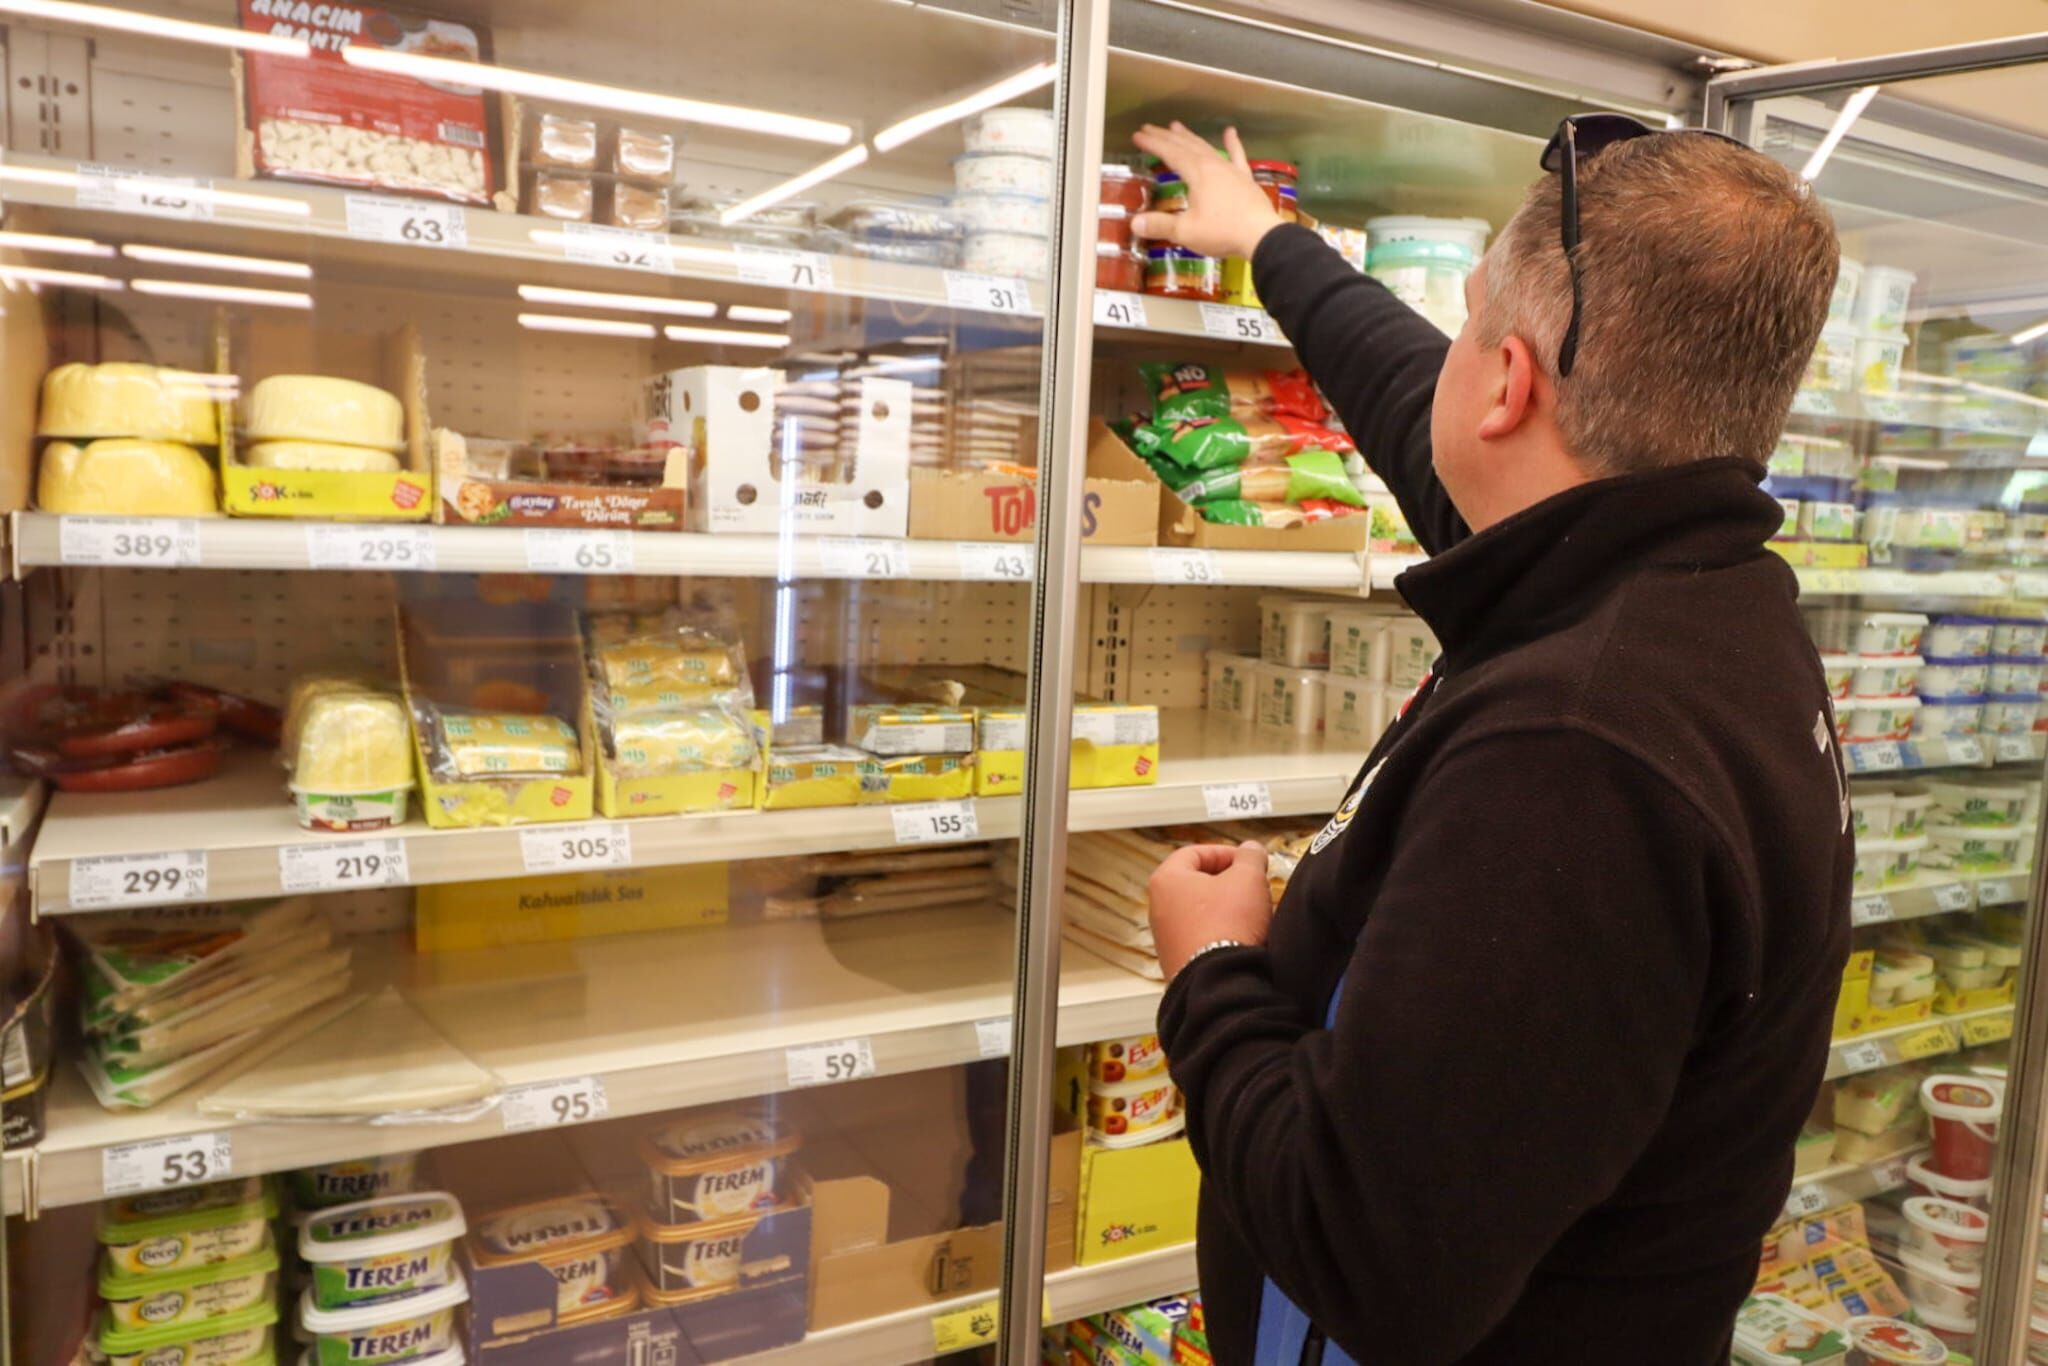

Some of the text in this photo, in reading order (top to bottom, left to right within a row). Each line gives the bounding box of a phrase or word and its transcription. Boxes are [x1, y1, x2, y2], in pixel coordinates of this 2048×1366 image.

[250, 0, 363, 34] ANACIM
[402, 218, 444, 242] 63
[792, 264, 814, 285] 71
[989, 290, 1015, 308] 31
[1107, 304, 1131, 323] 41
[1236, 318, 1262, 338] 55
[114, 534, 172, 556] 389
[361, 540, 412, 561] 295
[575, 544, 612, 568] 65
[865, 552, 891, 575] 21
[994, 556, 1025, 577] 43
[1184, 560, 1209, 581] 33
[1229, 794, 1258, 812] 469
[930, 815, 961, 834] 155
[561, 838, 609, 860] 305
[335, 855, 381, 879] 219
[123, 867, 180, 894] 299
[618, 885, 644, 901] Sos
[826, 1053, 857, 1080] 59
[552, 1092, 590, 1124] 95
[162, 1150, 207, 1184] 53
[316, 1170, 389, 1195] TEREM
[703, 1168, 766, 1195] TEREM
[328, 1206, 432, 1237] TEREM
[142, 1244, 180, 1261] Becel
[694, 1237, 742, 1261] TERE
[346, 1256, 428, 1290] TEREM
[554, 1259, 598, 1284] REM
[143, 1297, 181, 1316] Becel
[349, 1321, 432, 1359] TEREM
[1103, 1311, 1143, 1356] TEREM
